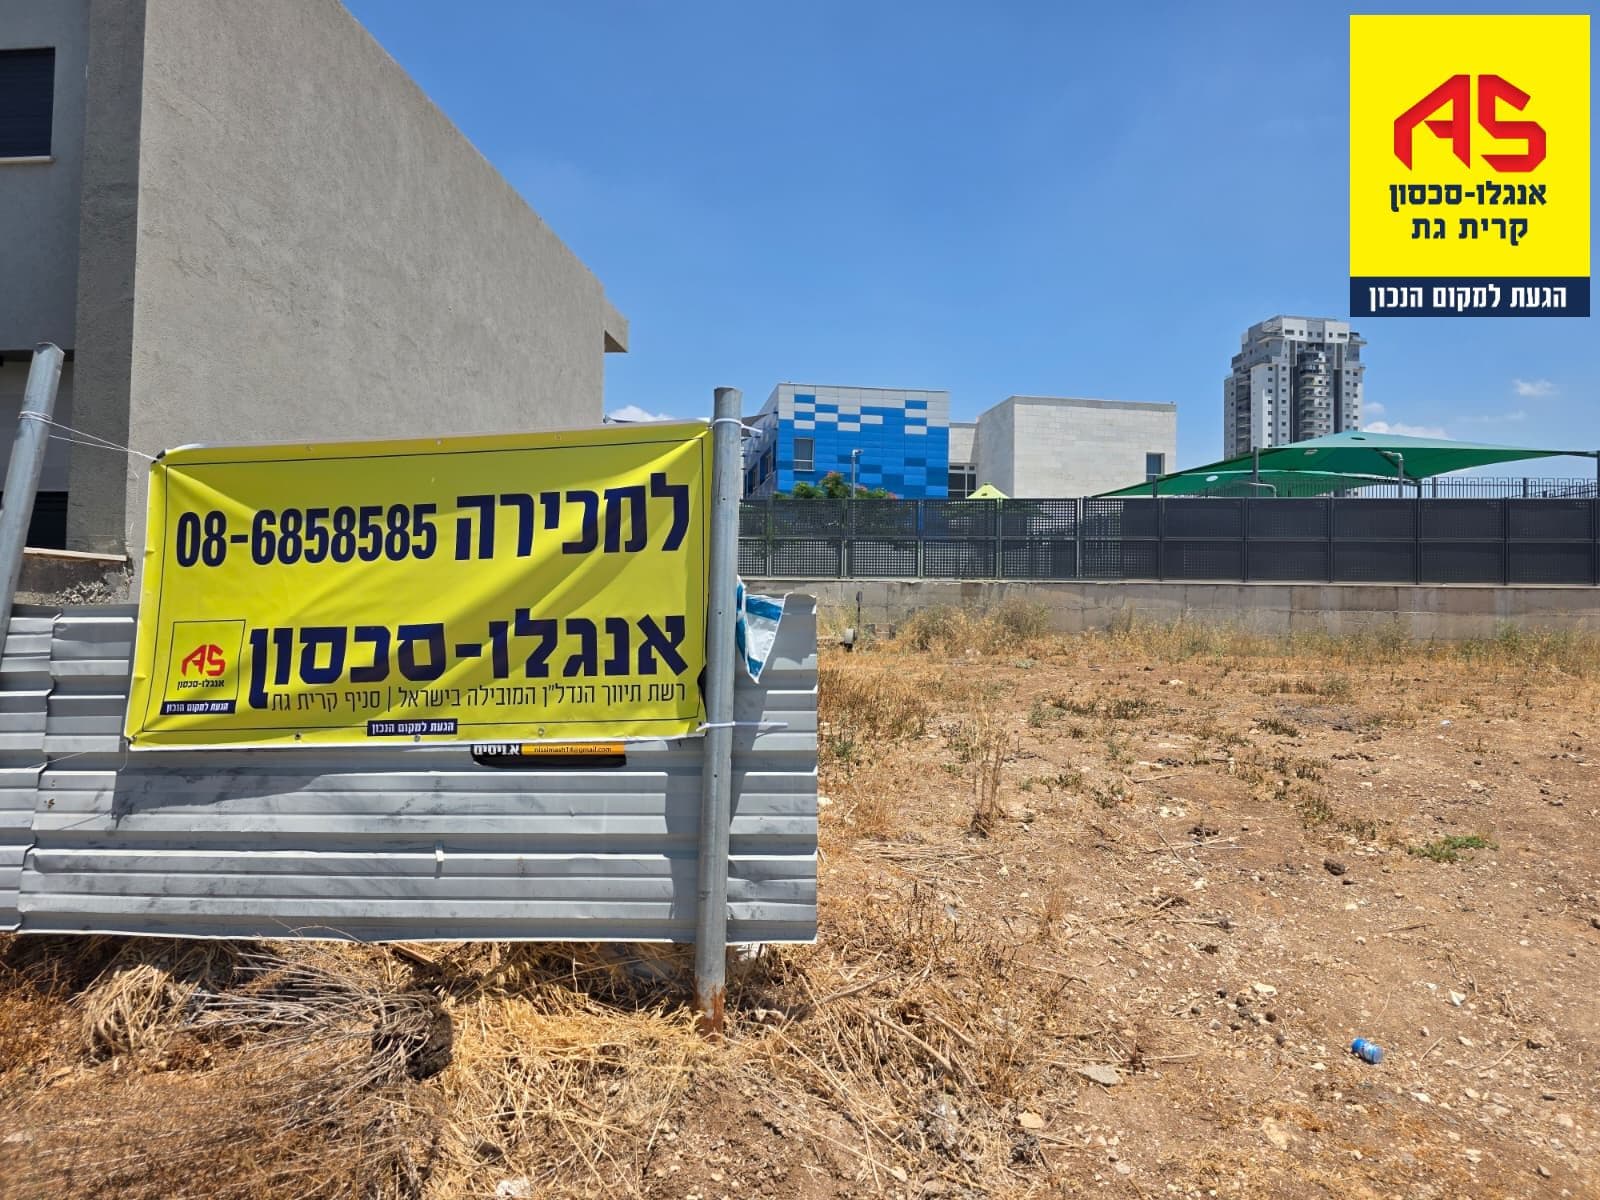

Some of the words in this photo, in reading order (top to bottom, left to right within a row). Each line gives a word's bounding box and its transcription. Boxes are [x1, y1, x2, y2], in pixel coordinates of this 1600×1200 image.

[454, 472, 690, 562] למכירה
[175, 502, 438, 568] 08-6858585
[181, 644, 226, 677] AS
[248, 608, 689, 709] אנגלו-סכסון
[177, 678, 225, 691] אנגלו-סכסון
[601, 683, 641, 706] תיווך
[648, 683, 685, 702] רשת
[271, 693, 291, 711] גת
[297, 691, 337, 712] קרית
[345, 690, 380, 712] סניף
[398, 686, 461, 708] בישראל
[467, 685, 536, 706] המובילה
[166, 703, 185, 713] הנכון
[186, 702, 210, 712] למקום
[210, 702, 230, 711] הגעת
[371, 723, 395, 735] הנכון
[397, 720, 427, 734] למקום
[429, 721, 455, 732] הגעת
